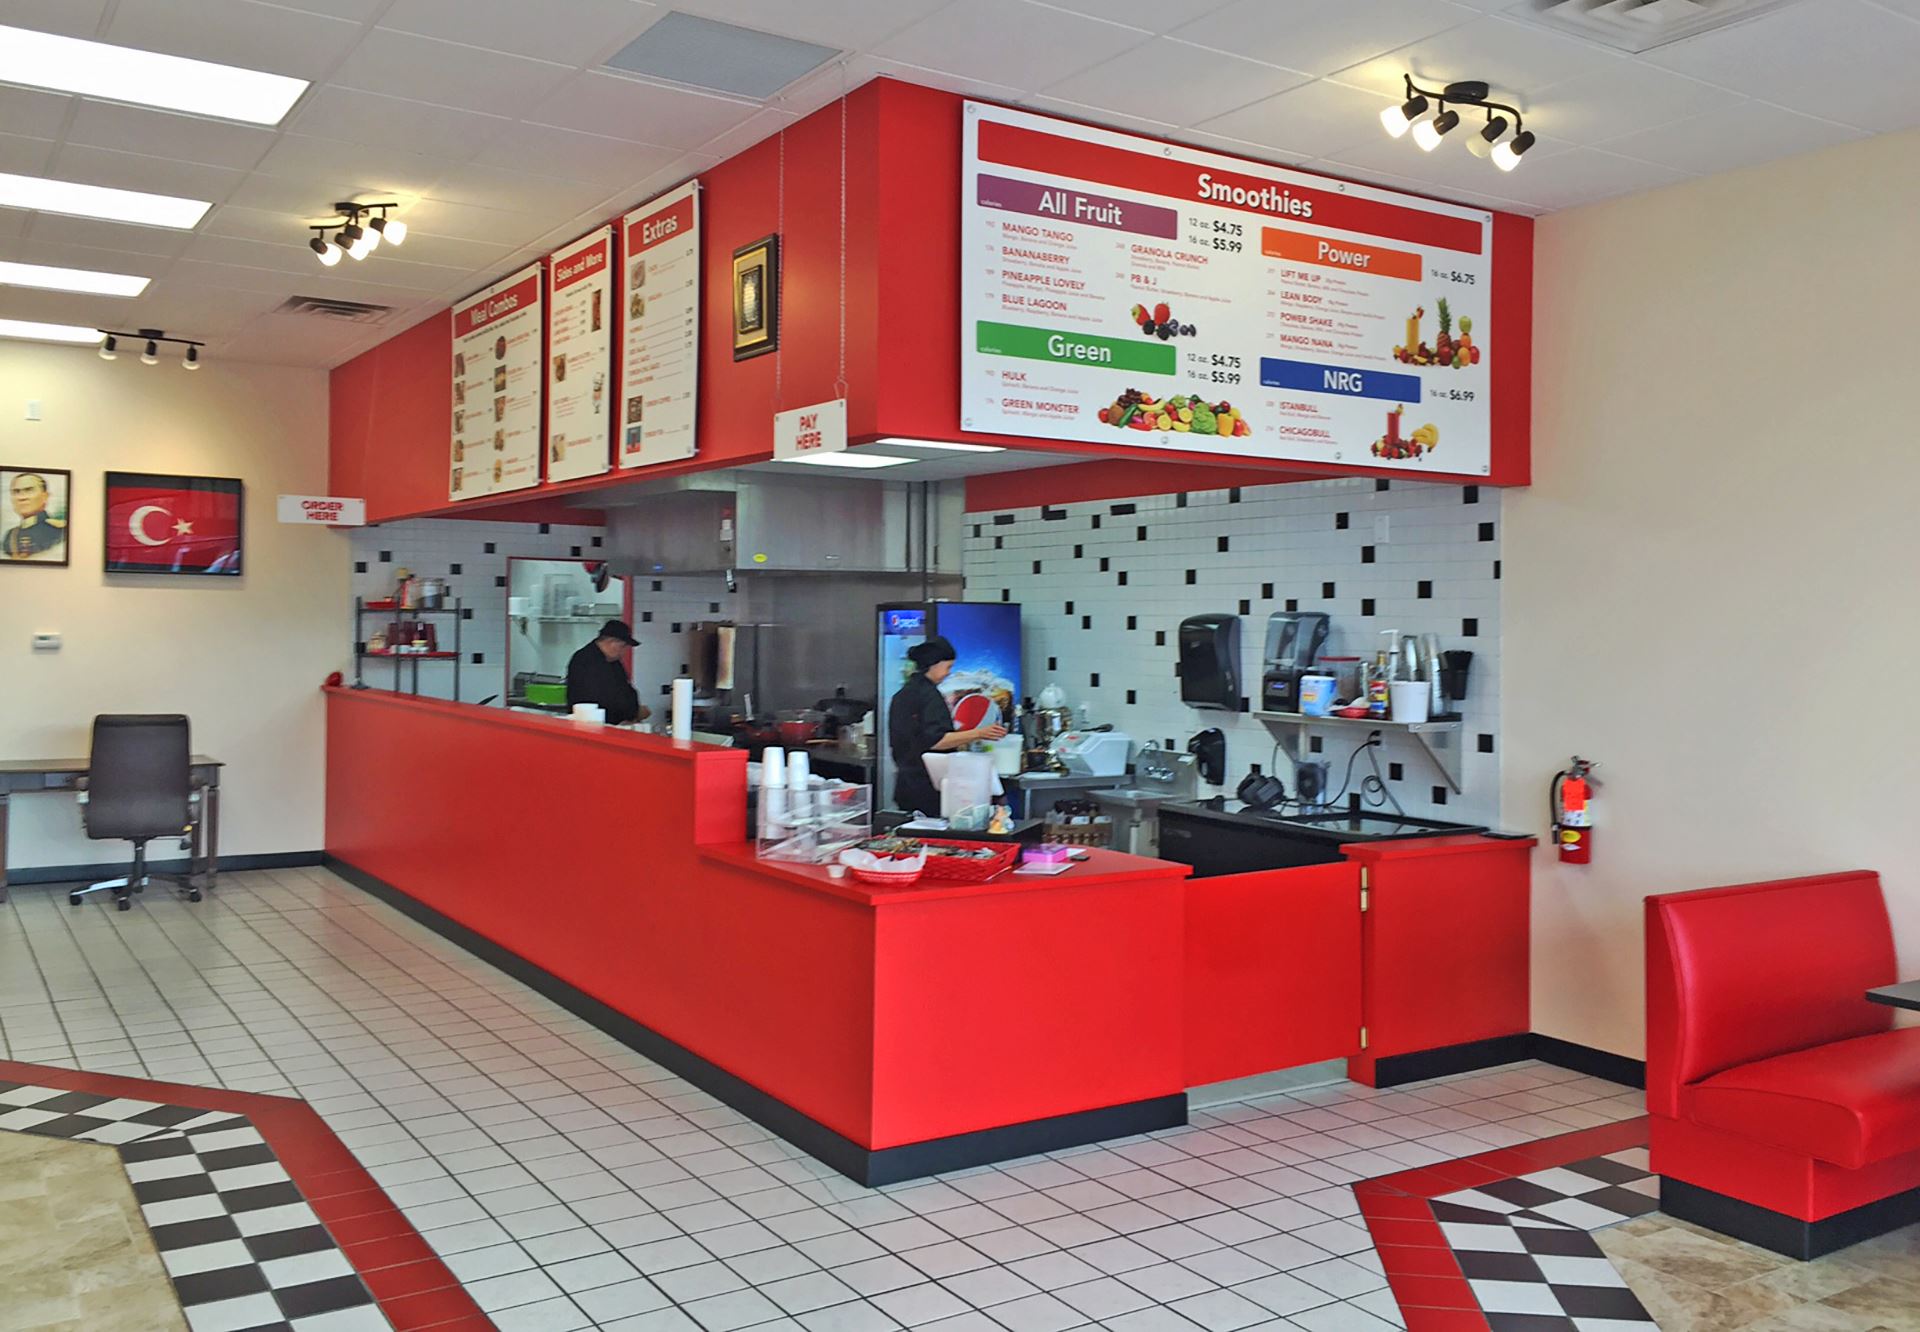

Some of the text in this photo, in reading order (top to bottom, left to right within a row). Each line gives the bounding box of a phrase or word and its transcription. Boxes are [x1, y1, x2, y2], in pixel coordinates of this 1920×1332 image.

[1198, 173, 1312, 218] Smoothies
[1038, 191, 1122, 225] All Fruit
[643, 215, 677, 245] Extras
[1002, 222, 1039, 236] MANGO
[1042, 229, 1073, 241] TANGO
[1188, 218, 1197, 227] 12
[1213, 220, 1242, 236] $4.75
[1131, 244, 1172, 259] GRANOLA
[1175, 251, 1208, 264] CRUNCH
[1213, 238, 1242, 253] $5.99
[1002, 246, 1070, 264] BANANABERRY
[1318, 241, 1371, 268] Power
[573, 257, 585, 274] and
[1002, 270, 1050, 285] PINEAPPLE
[1053, 277, 1085, 290] LOVELY
[1131, 273, 1141, 283] PB
[1451, 271, 1475, 285] $6.75
[1002, 294, 1024, 305] BLUE
[1027, 297, 1067, 311] LAGOON
[1281, 291, 1300, 301] LEAN
[1302, 294, 1322, 304] BODY
[1280, 312, 1307, 323] POWER
[1309, 316, 1333, 327] SHAKE
[1048, 335, 1111, 362] Green
[1280, 334, 1309, 345] MANGO
[1312, 338, 1333, 348] NANA
[1211, 354, 1241, 368] $4.75
[1002, 370, 1026, 381] HULK
[1211, 371, 1241, 384] $5.99
[1324, 370, 1362, 392] NRG
[1450, 389, 1475, 401] $6.99
[1002, 398, 1032, 409] GREEN
[1035, 401, 1079, 413] MONSTER
[799, 413, 818, 432] PAY
[795, 431, 822, 451] HERE
[302, 500, 344, 511] ORDER
[306, 511, 338, 520] HERE
